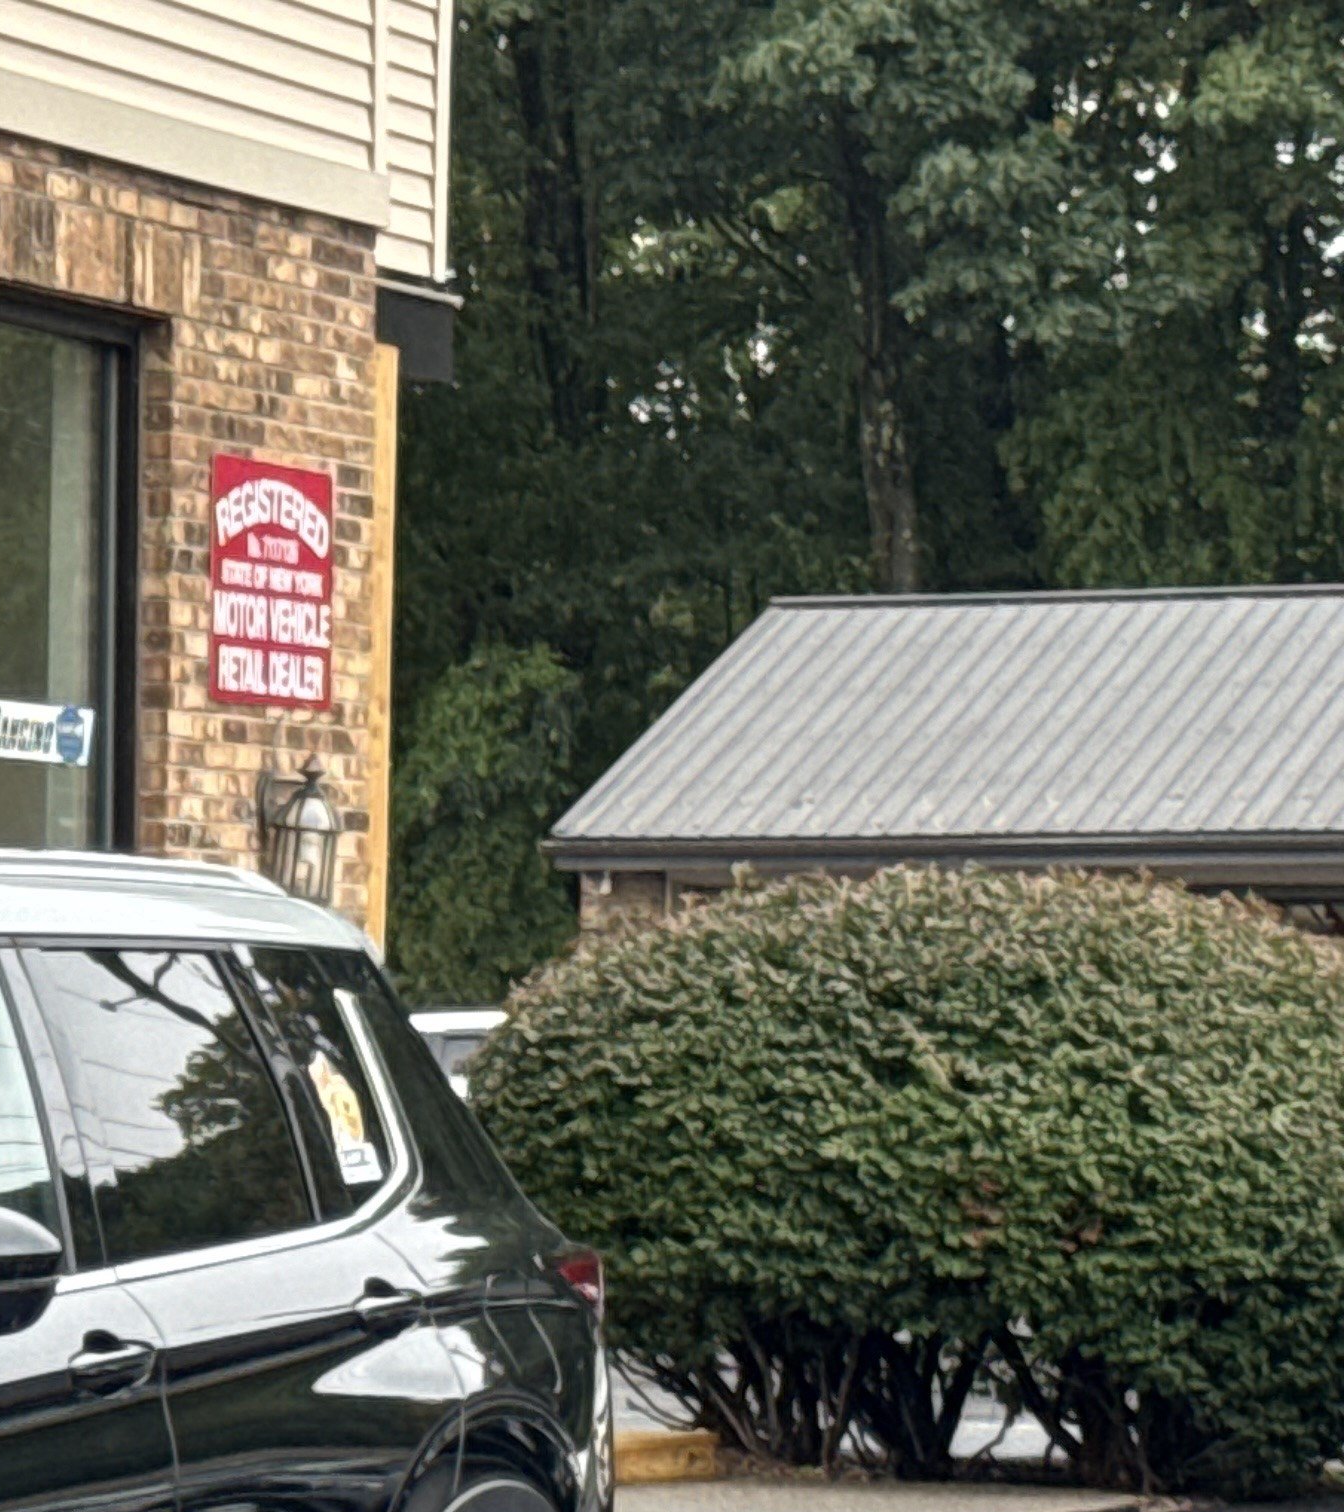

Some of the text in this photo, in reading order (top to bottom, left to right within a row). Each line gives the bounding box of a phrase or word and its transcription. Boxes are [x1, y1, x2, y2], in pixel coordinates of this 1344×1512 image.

[215, 478, 329, 559] REGISTERED
[213, 590, 331, 648] MOTOR VEHICLE
[217, 643, 324, 701] RETAIL DEALER
